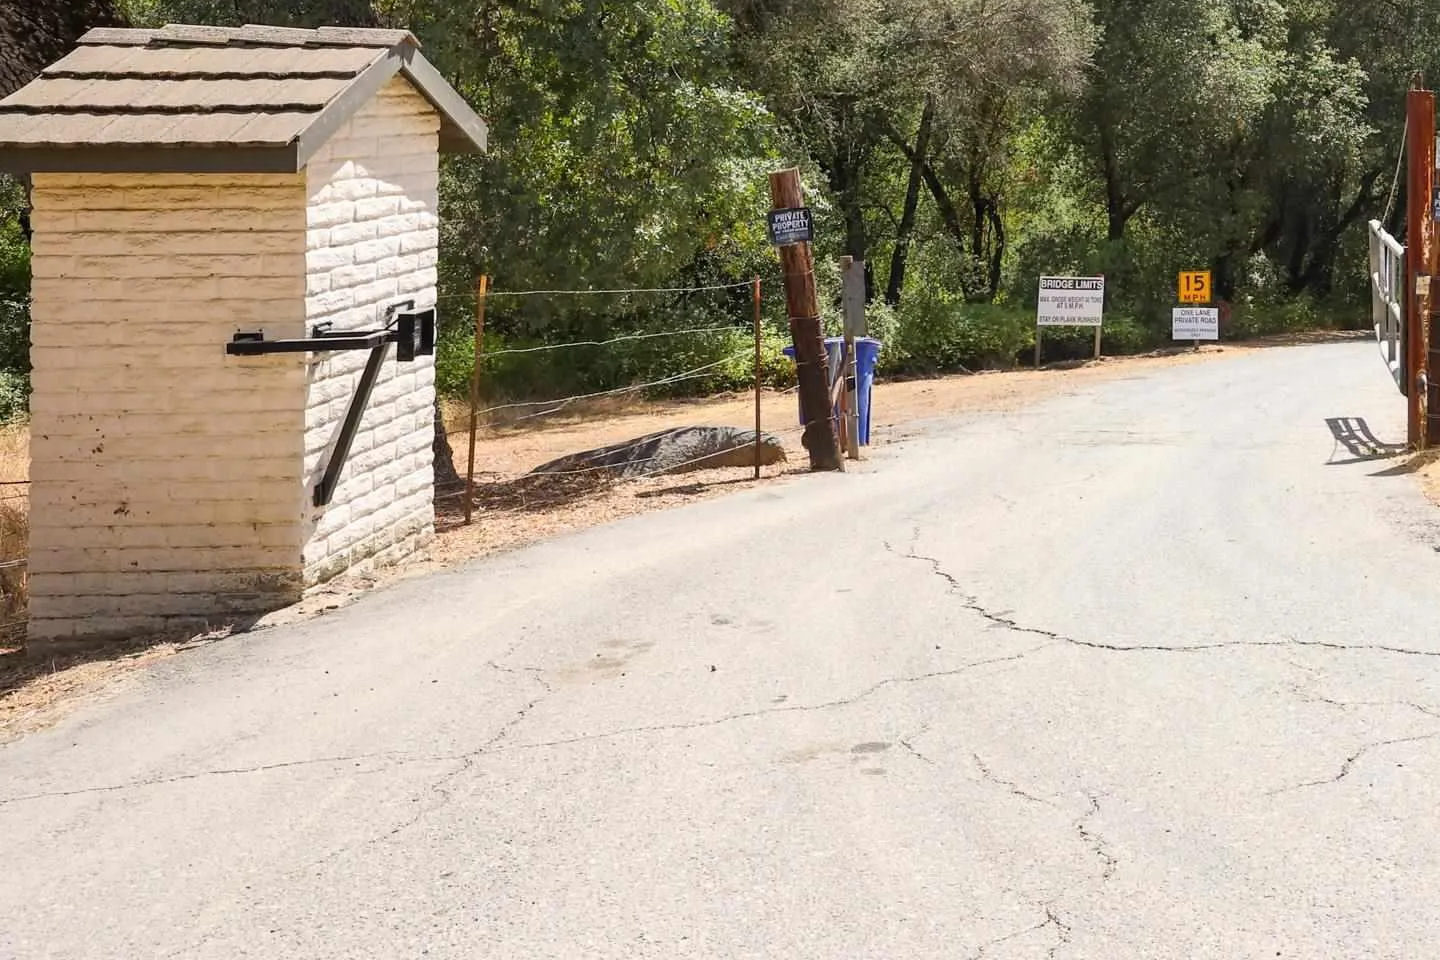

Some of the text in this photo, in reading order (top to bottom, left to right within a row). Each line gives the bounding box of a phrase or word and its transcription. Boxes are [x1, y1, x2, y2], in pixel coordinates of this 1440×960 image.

[775, 211, 805, 222] PRIVATE
[772, 219, 809, 231] PROPERTY
[1041, 279, 1104, 289] BRIDGE LIMITS
[1185, 275, 1205, 291] 15
[1174, 316, 1217, 324] PRIVATE ROAD
